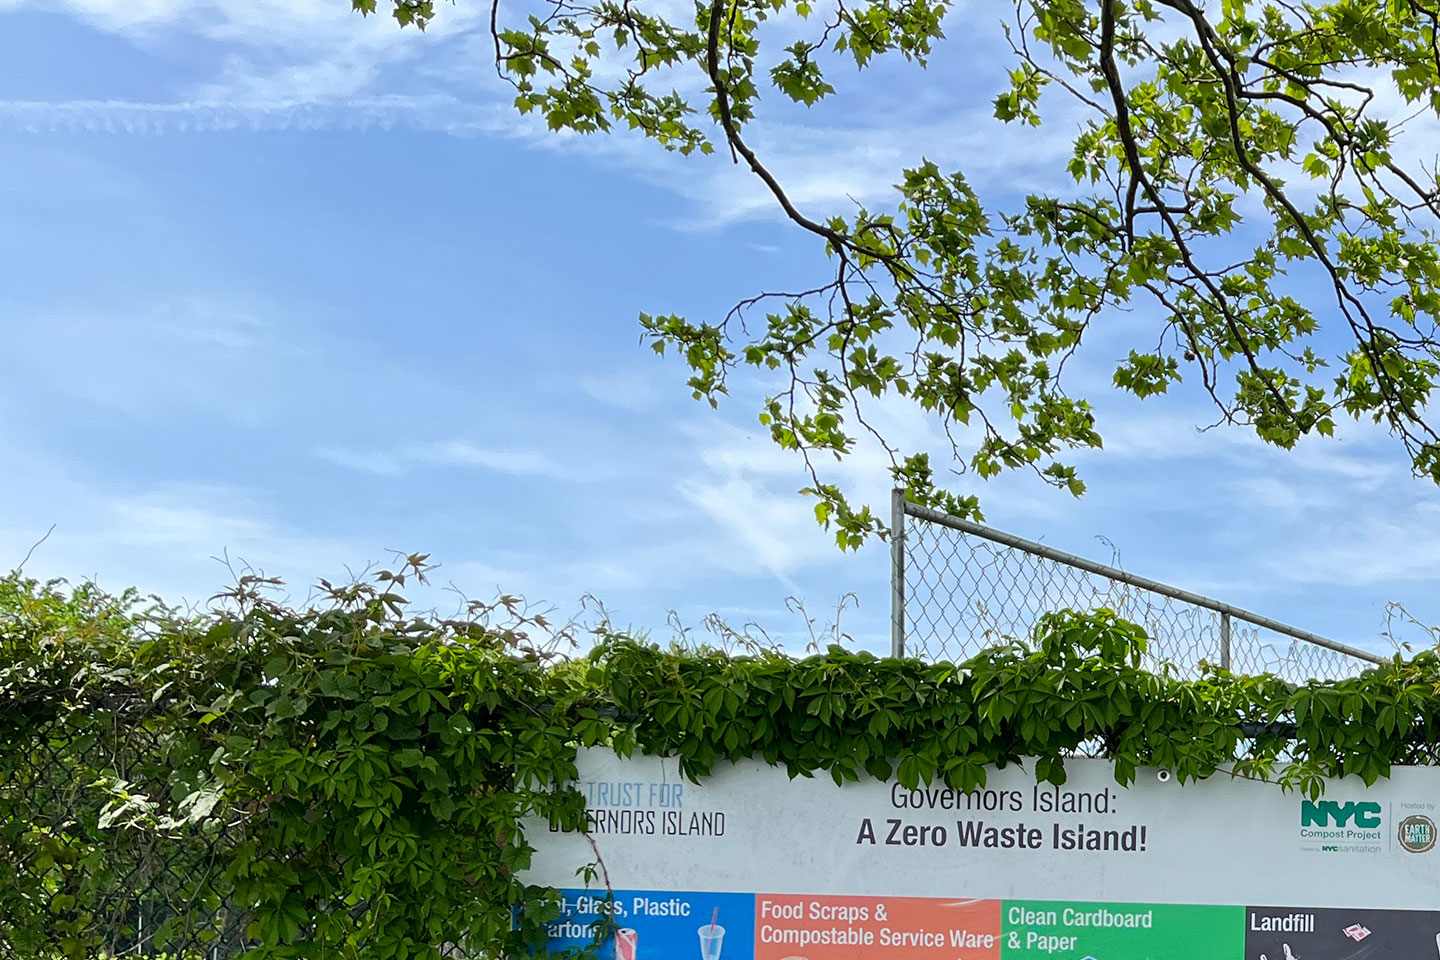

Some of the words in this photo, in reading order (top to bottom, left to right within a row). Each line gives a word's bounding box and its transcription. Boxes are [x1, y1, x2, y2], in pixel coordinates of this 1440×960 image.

[587, 782, 643, 807] TRUST
[649, 783, 683, 808] FOR
[891, 782, 1022, 811] Governors
[1033, 785, 1117, 814] Island:
[1301, 800, 1381, 828] NYC
[1400, 802, 1426, 810] Hosted
[1427, 803, 1435, 811] by
[549, 809, 655, 835] ERNORS
[662, 811, 725, 836] ISLAND
[1404, 824, 1430, 834] EARTH
[856, 818, 876, 845] A
[885, 819, 947, 847] Zero
[957, 821, 1042, 849] Waste
[1300, 829, 1344, 839] Compost
[1346, 830, 1381, 841] Project
[1404, 833, 1431, 843] MATTER
[577, 896, 627, 917] Glass,
[633, 897, 691, 917] Plastic
[761, 900, 803, 919] Food
[809, 902, 869, 924] Scraps
[874, 904, 888, 921] &
[1008, 907, 1056, 926] Clean
[1062, 908, 1152, 928] Cardboard
[1250, 913, 1315, 932] Landfill
[543, 920, 602, 938] artons
[760, 925, 874, 947] Compostable
[879, 928, 945, 948] Service
[950, 929, 994, 949] Ware
[1007, 932, 1021, 949] &
[1026, 932, 1077, 953] Paper
